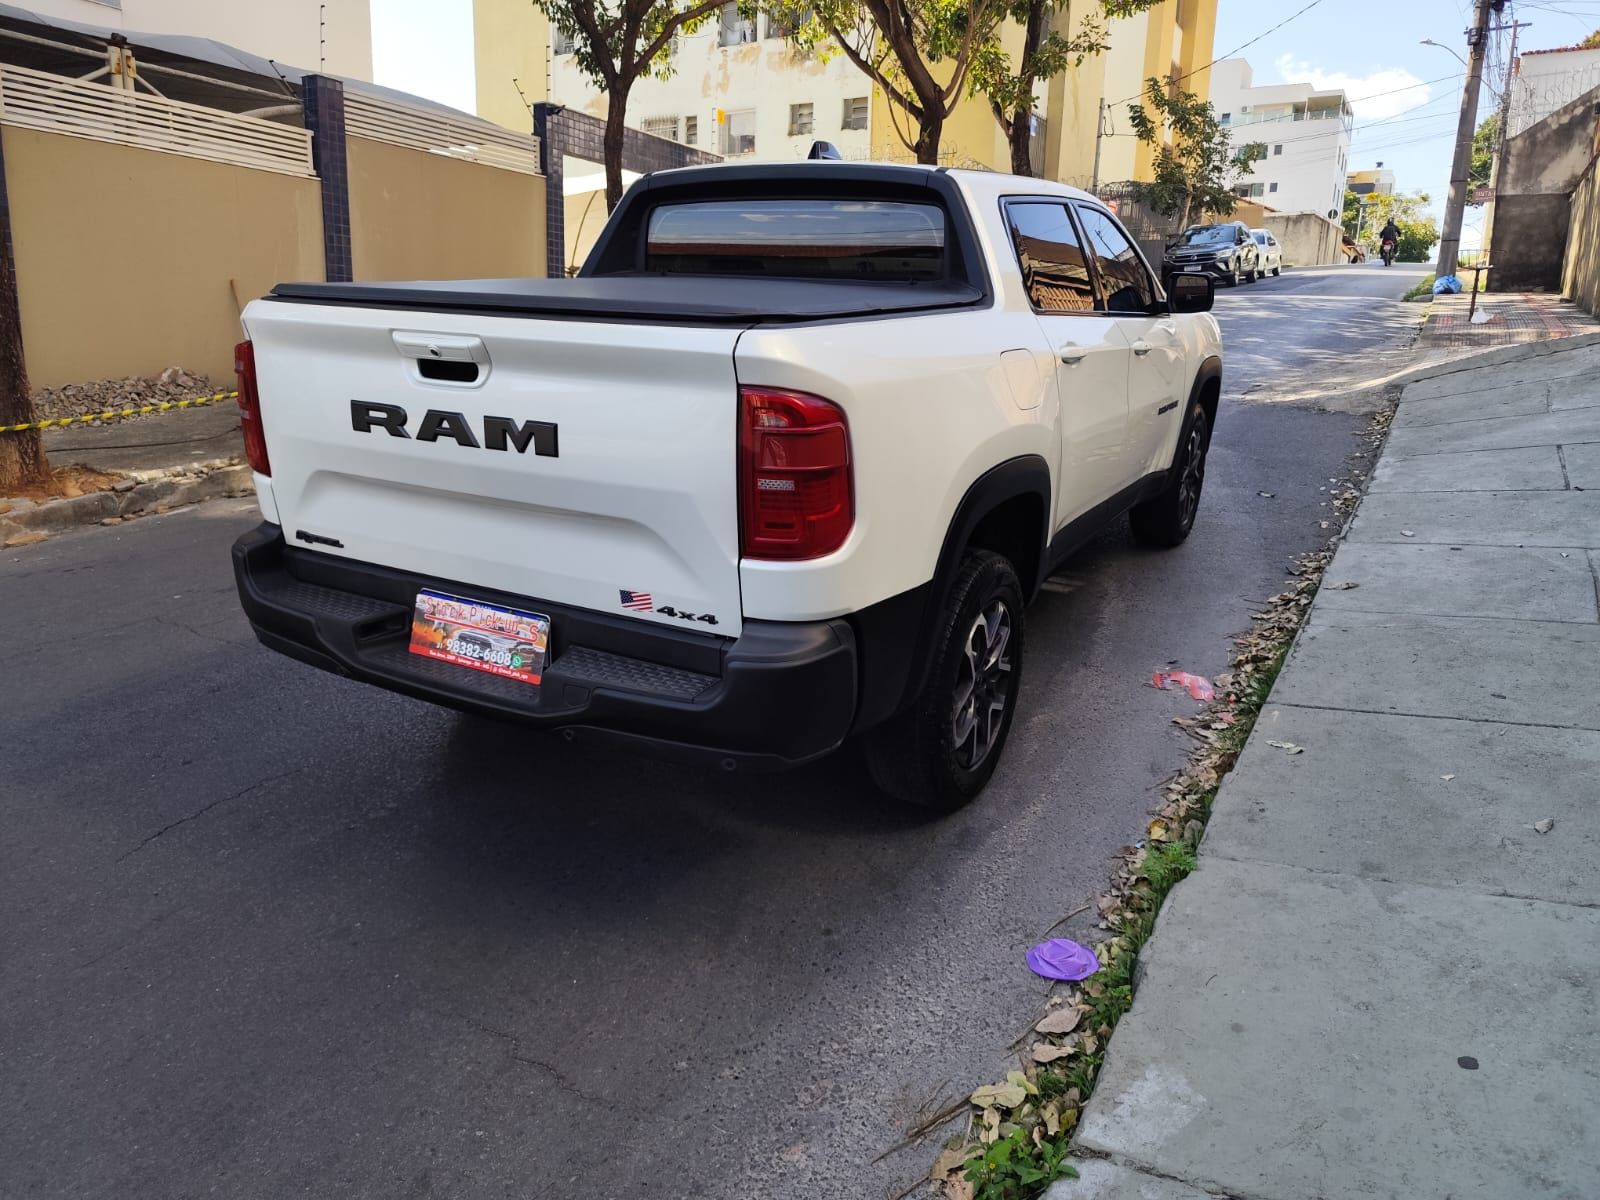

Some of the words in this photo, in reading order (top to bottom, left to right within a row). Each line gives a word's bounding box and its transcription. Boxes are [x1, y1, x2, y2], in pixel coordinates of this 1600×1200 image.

[350, 399, 559, 458] RAM
[656, 605, 719, 625] 4x4
[446, 638, 512, 666] 98382-6608
